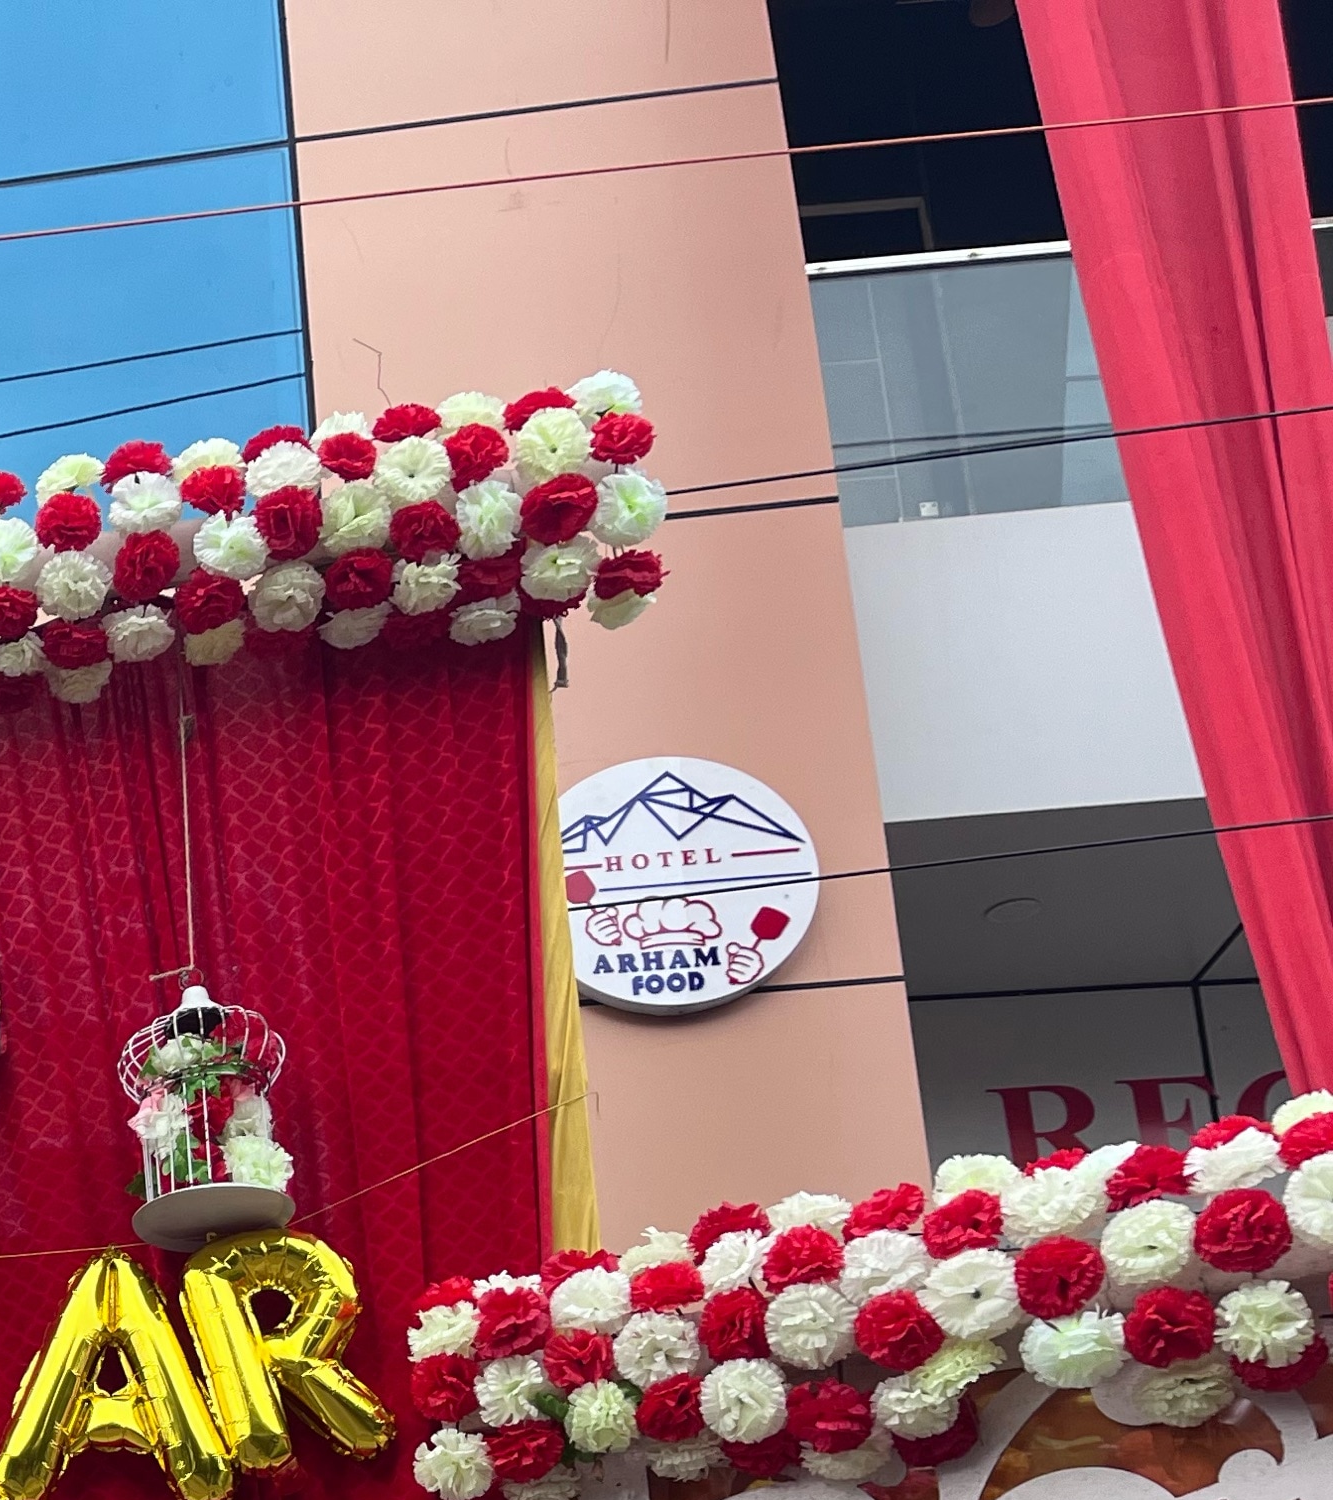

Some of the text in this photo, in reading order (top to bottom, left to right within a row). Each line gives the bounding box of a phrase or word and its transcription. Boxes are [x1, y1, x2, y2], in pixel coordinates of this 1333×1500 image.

[604, 848, 722, 872] HOTEL
[593, 946, 721, 974] ARHAM
[631, 971, 705, 996] FOOD
